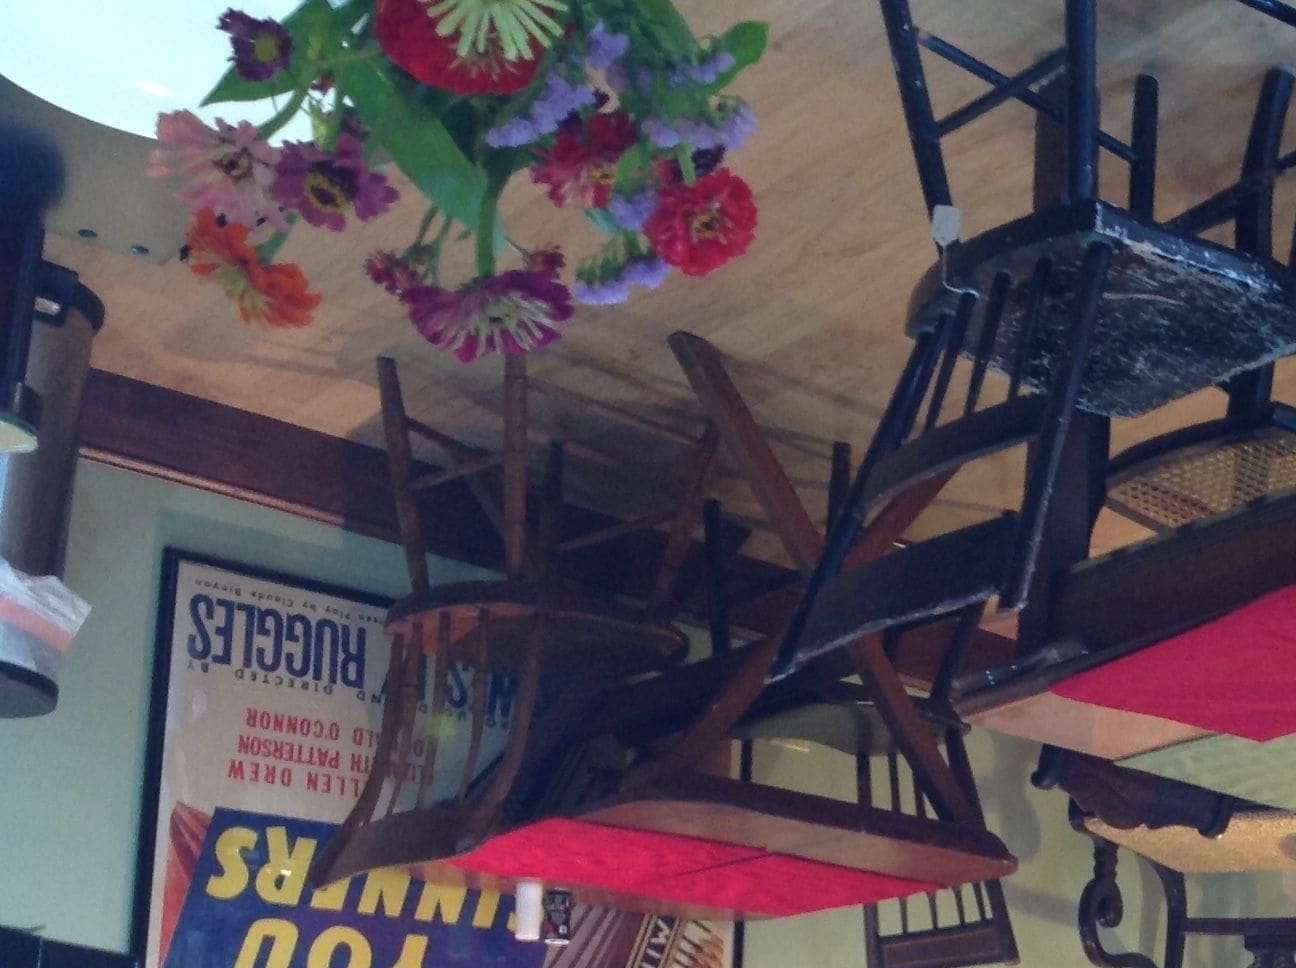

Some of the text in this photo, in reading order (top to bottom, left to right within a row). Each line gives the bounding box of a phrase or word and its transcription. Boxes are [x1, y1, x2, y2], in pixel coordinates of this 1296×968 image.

[185, 592, 367, 690] RUGGLES
[233, 668, 333, 696] DIRECTED
[354, 689, 383, 705] ND
[244, 707, 340, 741] O'CONNOR
[236, 734, 341, 769] PATTERSON
[226, 758, 360, 799] LLEN DREW
[204, 824, 517, 933] INNRS
